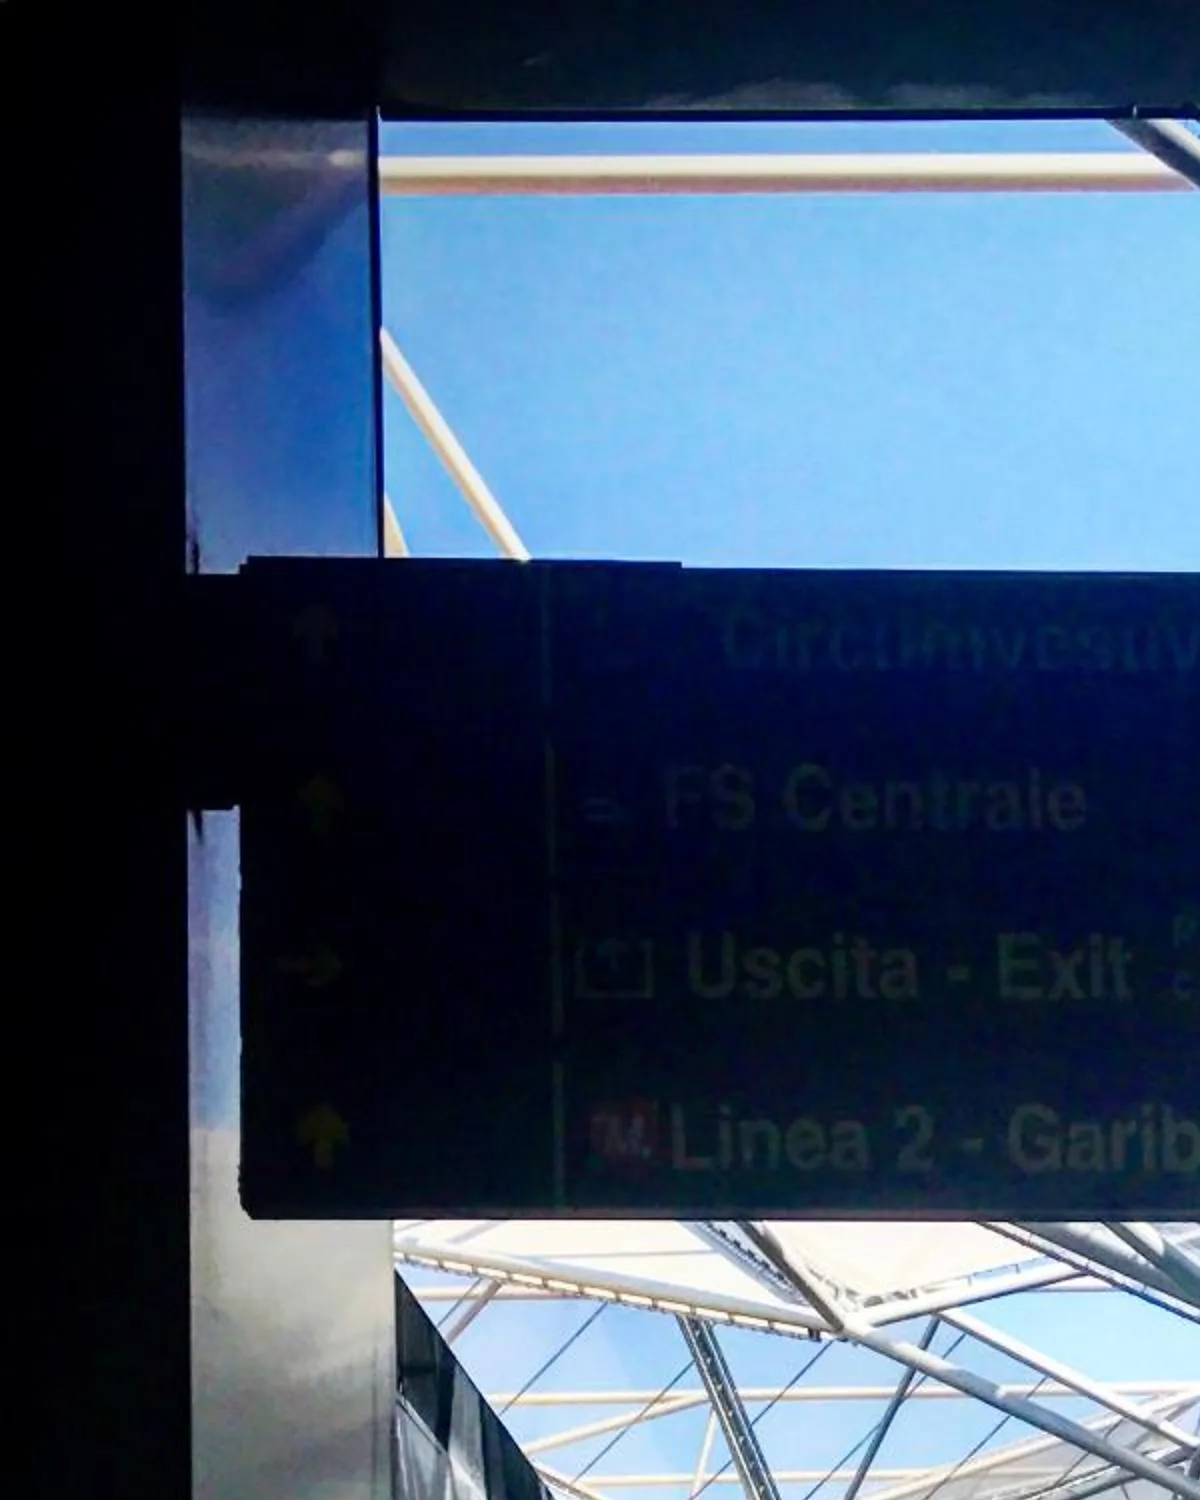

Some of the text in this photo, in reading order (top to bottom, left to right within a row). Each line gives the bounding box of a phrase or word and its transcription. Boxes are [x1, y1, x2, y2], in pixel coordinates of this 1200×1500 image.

[662, 760, 1089, 832] FS Centrale
[686, 930, 921, 1001] Uscita
[996, 930, 1135, 1003] Exit
[671, 1104, 869, 1171] Linea
[895, 1104, 937, 1172] 2
